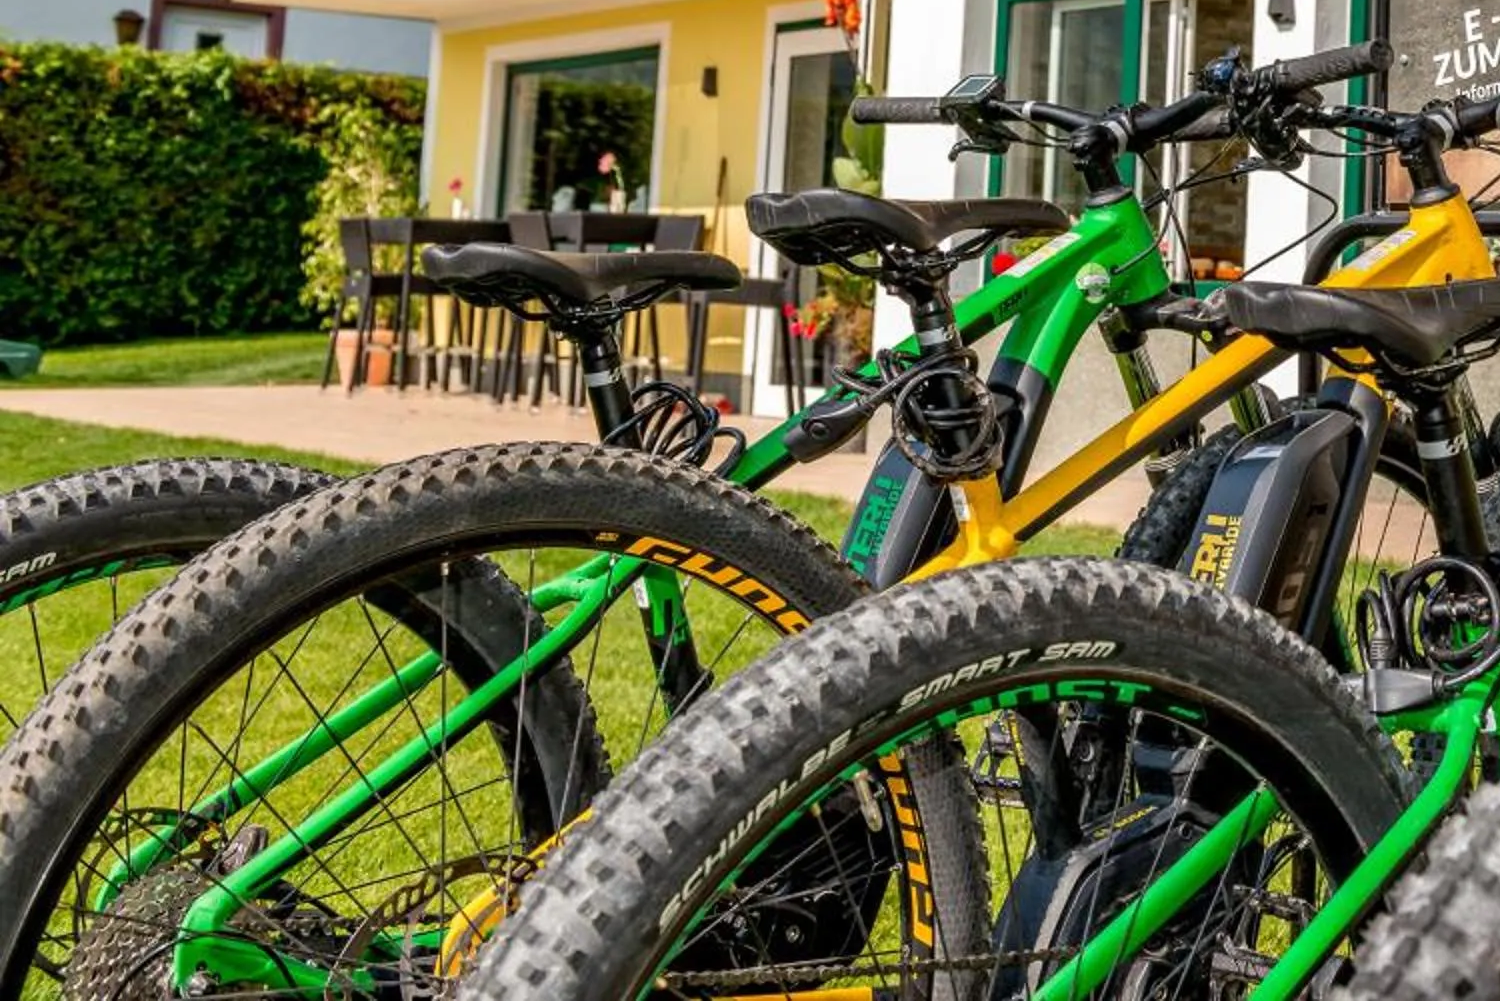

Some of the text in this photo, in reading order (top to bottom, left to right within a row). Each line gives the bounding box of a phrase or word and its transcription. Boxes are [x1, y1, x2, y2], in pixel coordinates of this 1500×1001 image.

[0, 552, 57, 584] AM
[659, 639, 1118, 936] SCHWALBE SMART SAM
